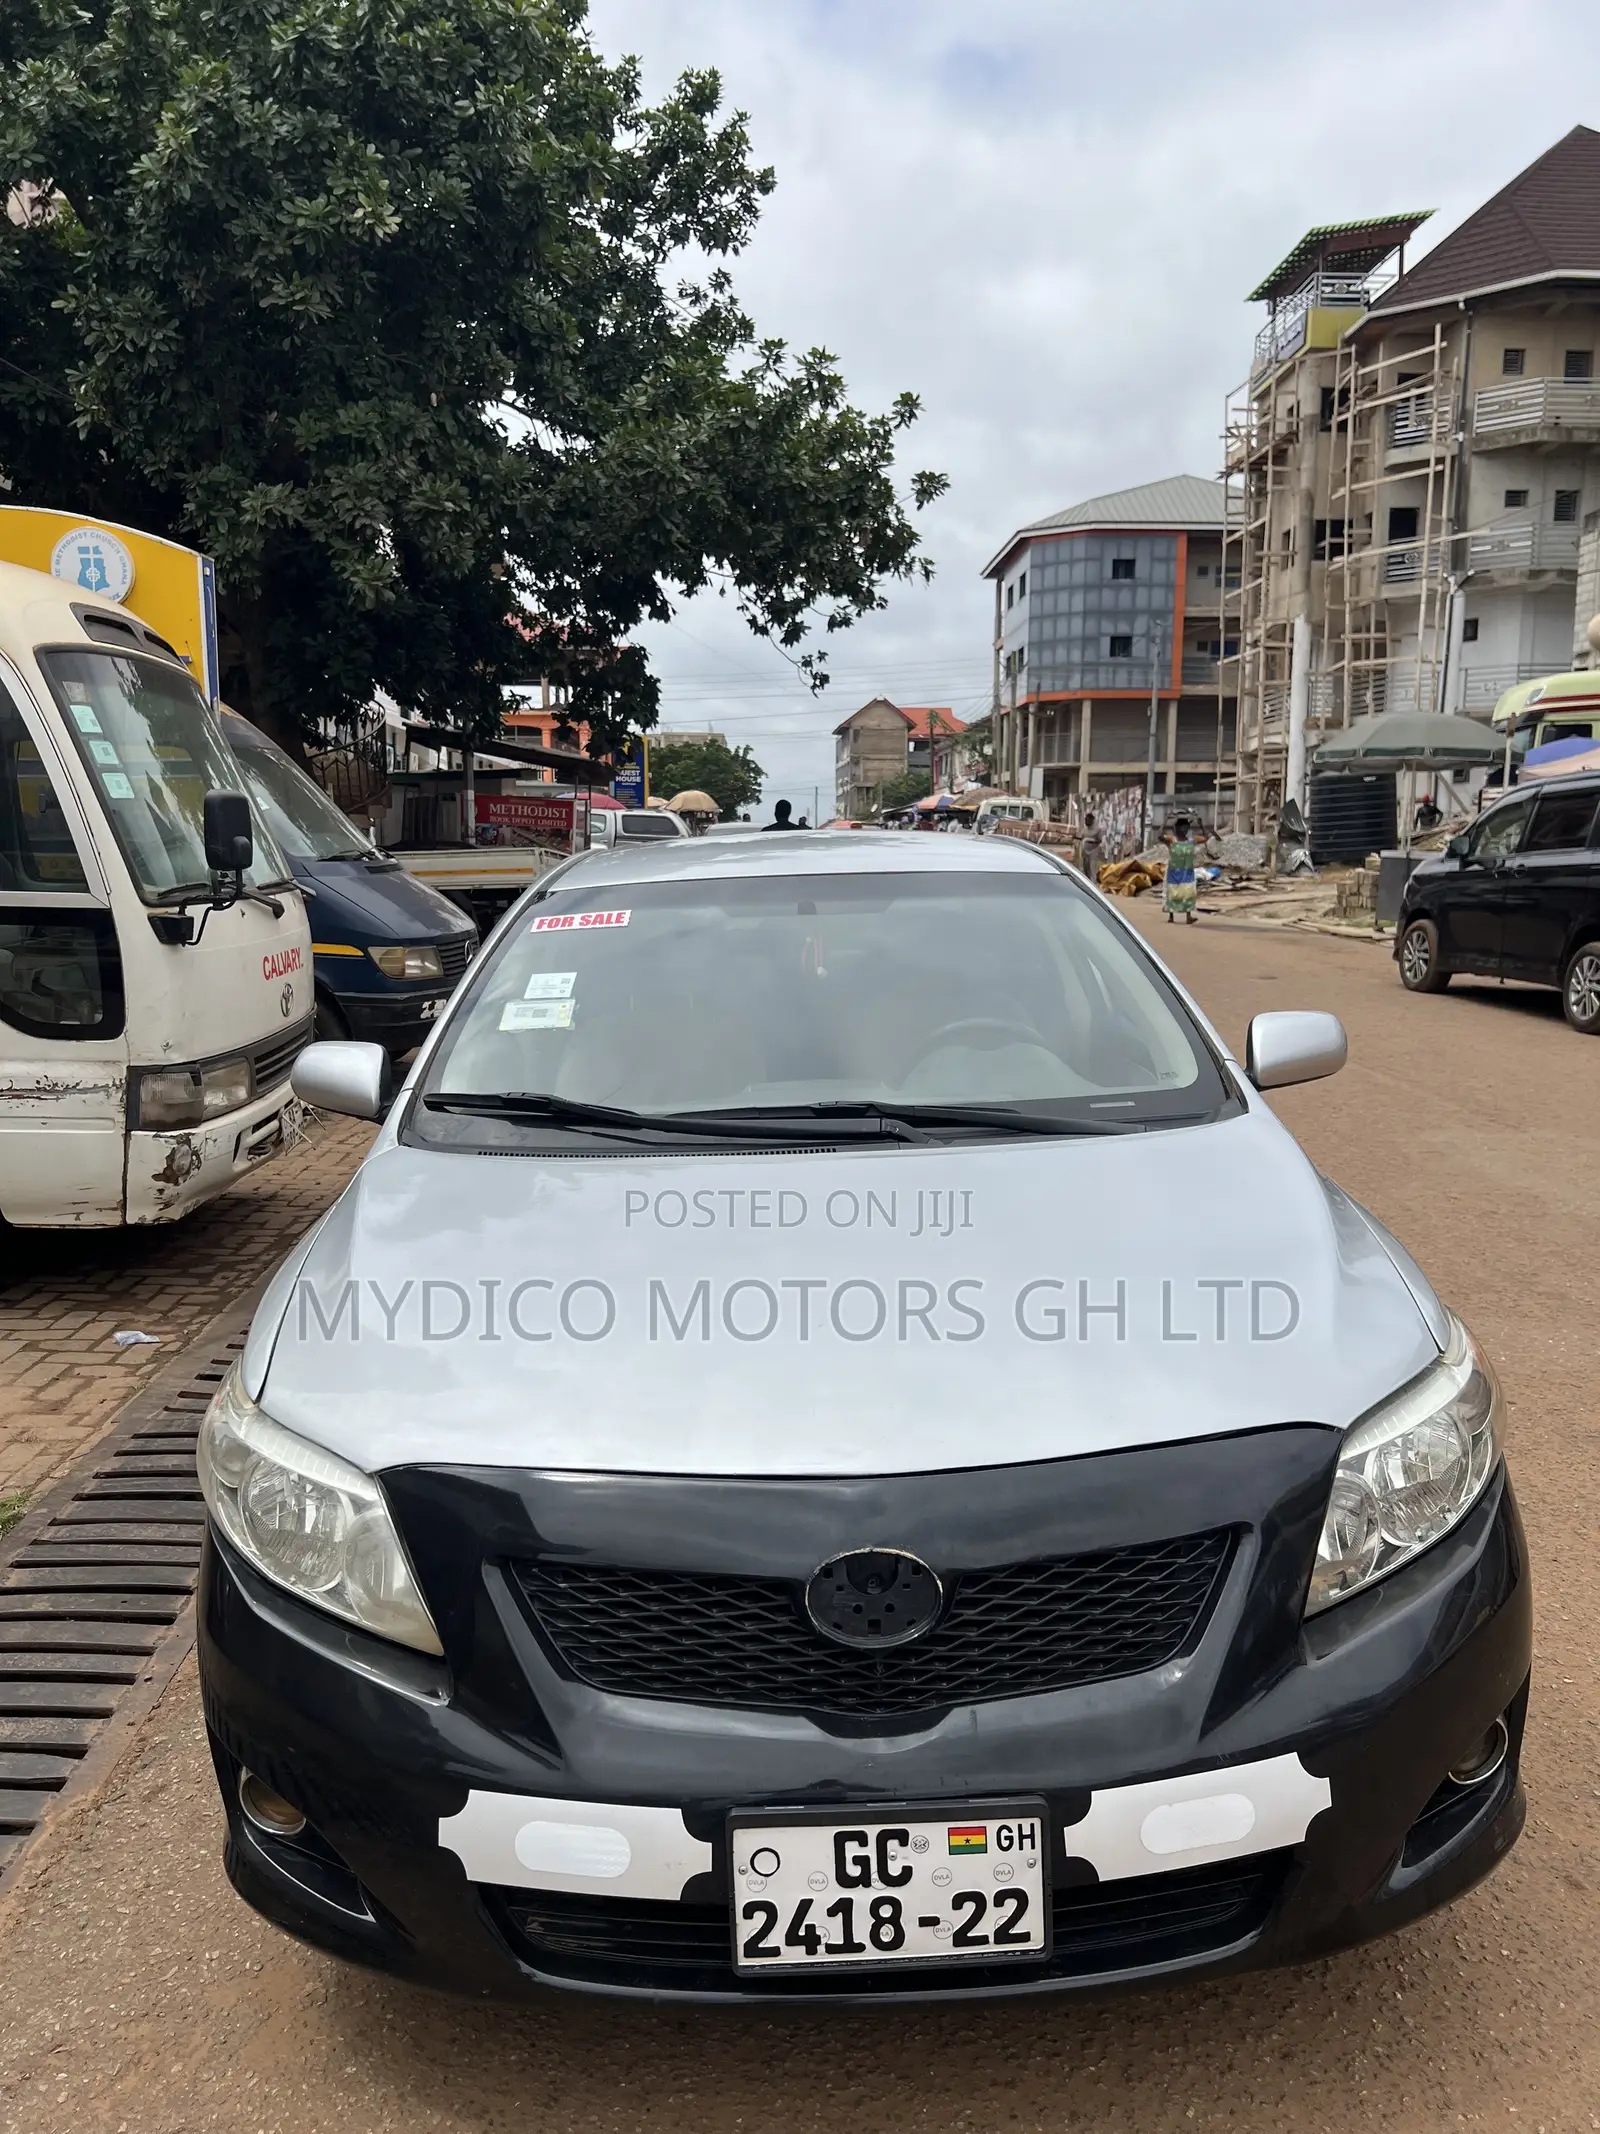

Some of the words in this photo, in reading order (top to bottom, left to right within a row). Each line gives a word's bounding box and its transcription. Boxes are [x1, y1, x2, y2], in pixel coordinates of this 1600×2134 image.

[55, 531, 88, 566] METHODIST
[90, 532, 121, 555] CHURCH
[119, 555, 128, 585] GHANA
[489, 803, 569, 818] METHODIST
[489, 815, 510, 824] BOOK
[512, 817, 535, 825] DEPOT
[538, 819, 567, 827] LIMITED
[536, 916, 575, 930] FOR
[579, 912, 626, 927] SALE
[996, 1823, 1036, 1852] GH
[833, 1828, 914, 1889] GC
